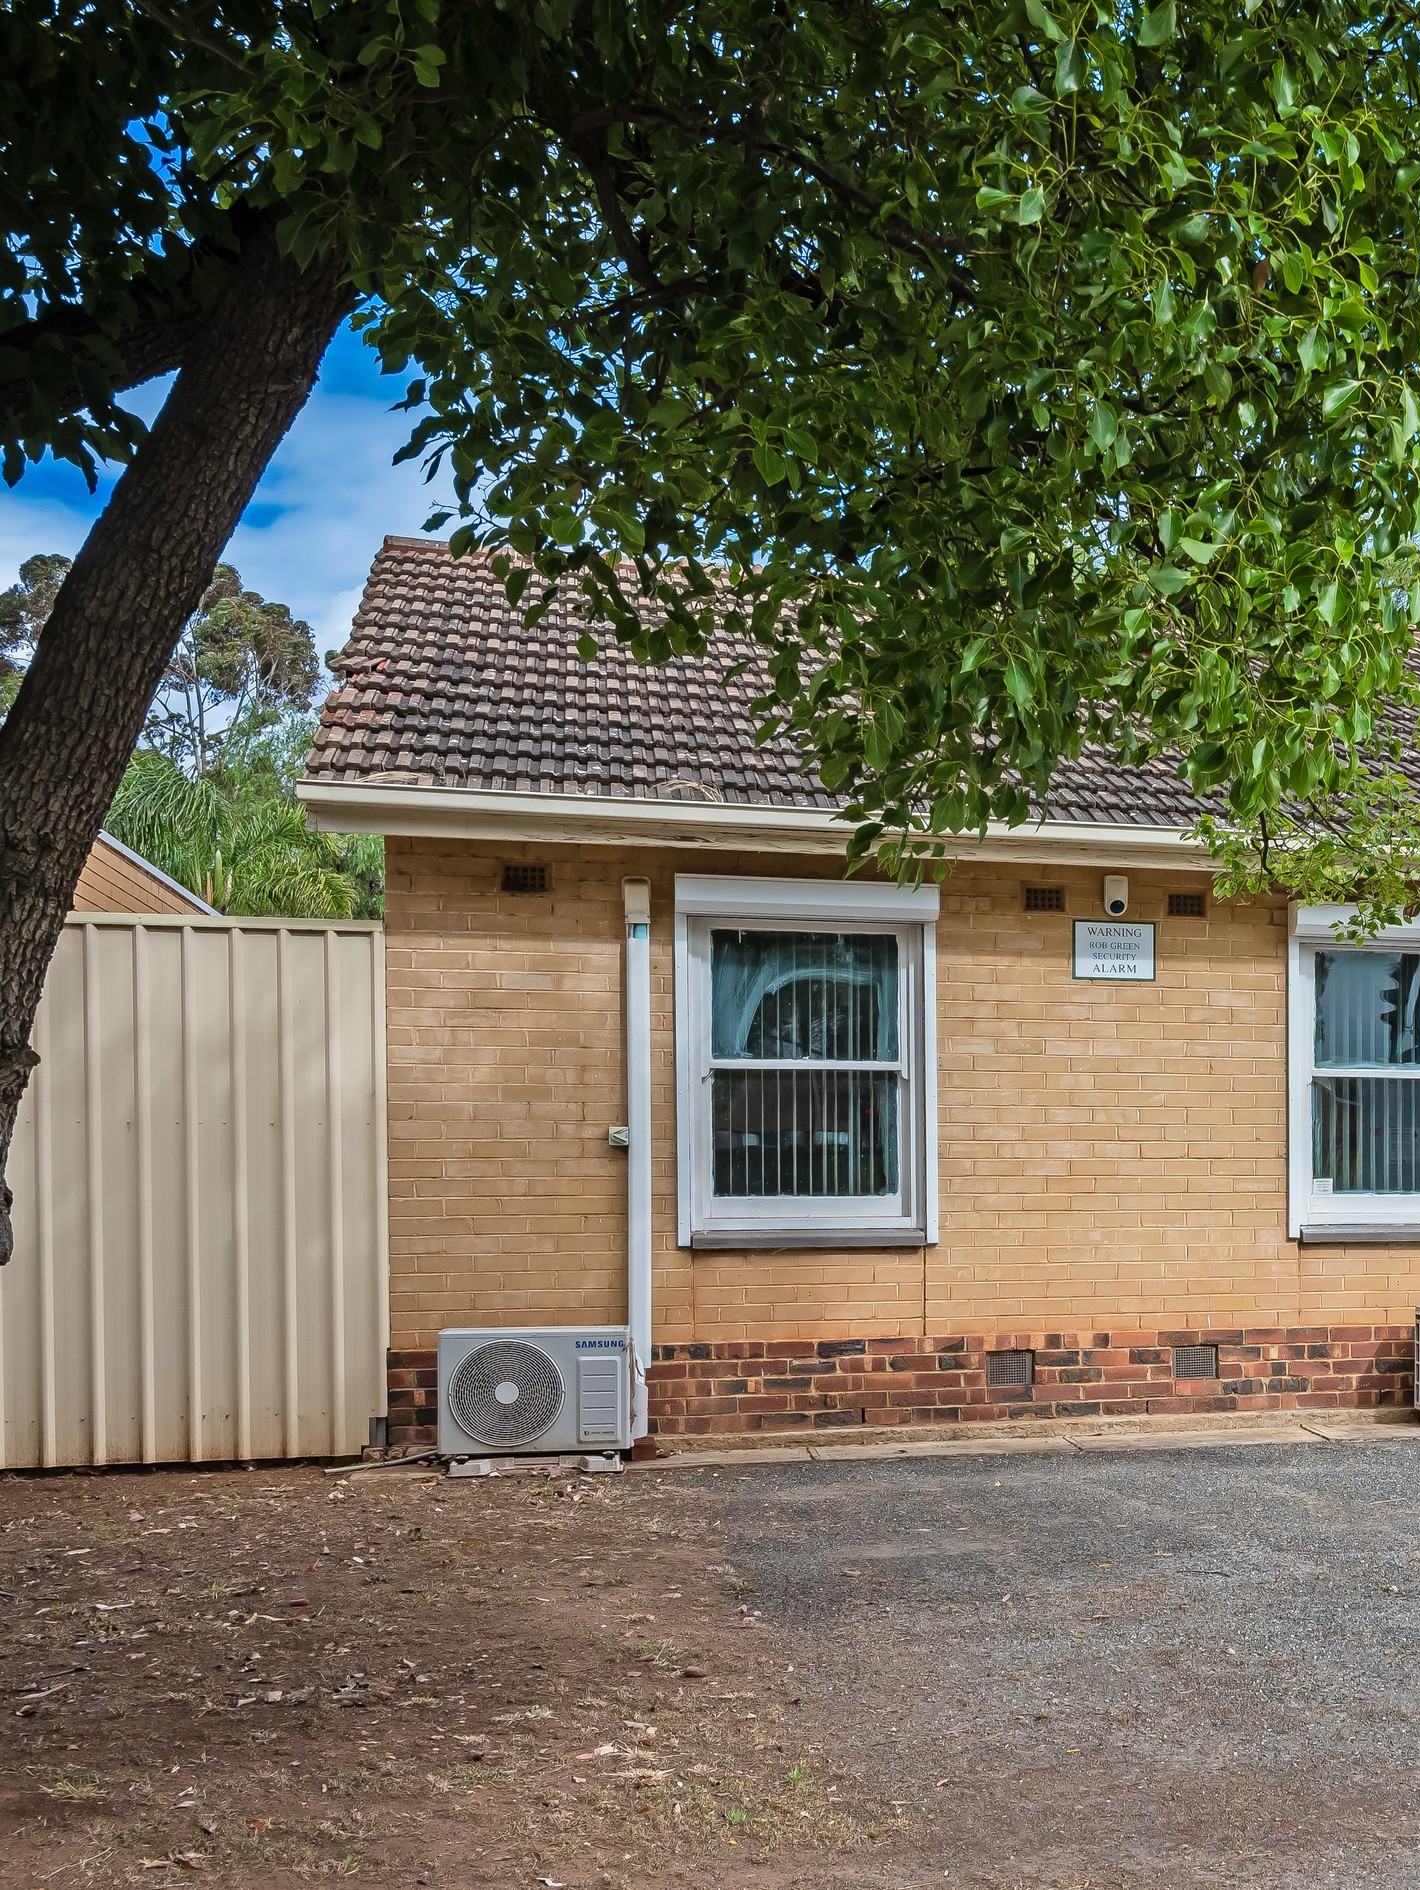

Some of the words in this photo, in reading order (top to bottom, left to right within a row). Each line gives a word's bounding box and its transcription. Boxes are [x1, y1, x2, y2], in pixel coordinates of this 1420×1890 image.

[1087, 926, 1142, 938] WARNING
[1089, 941, 1108, 949] ROB
[1110, 942, 1140, 950] GREEN
[1092, 952, 1137, 961] SECURITY
[1092, 963, 1137, 974] ALARM
[575, 1340, 624, 1349] SAMSUNG
